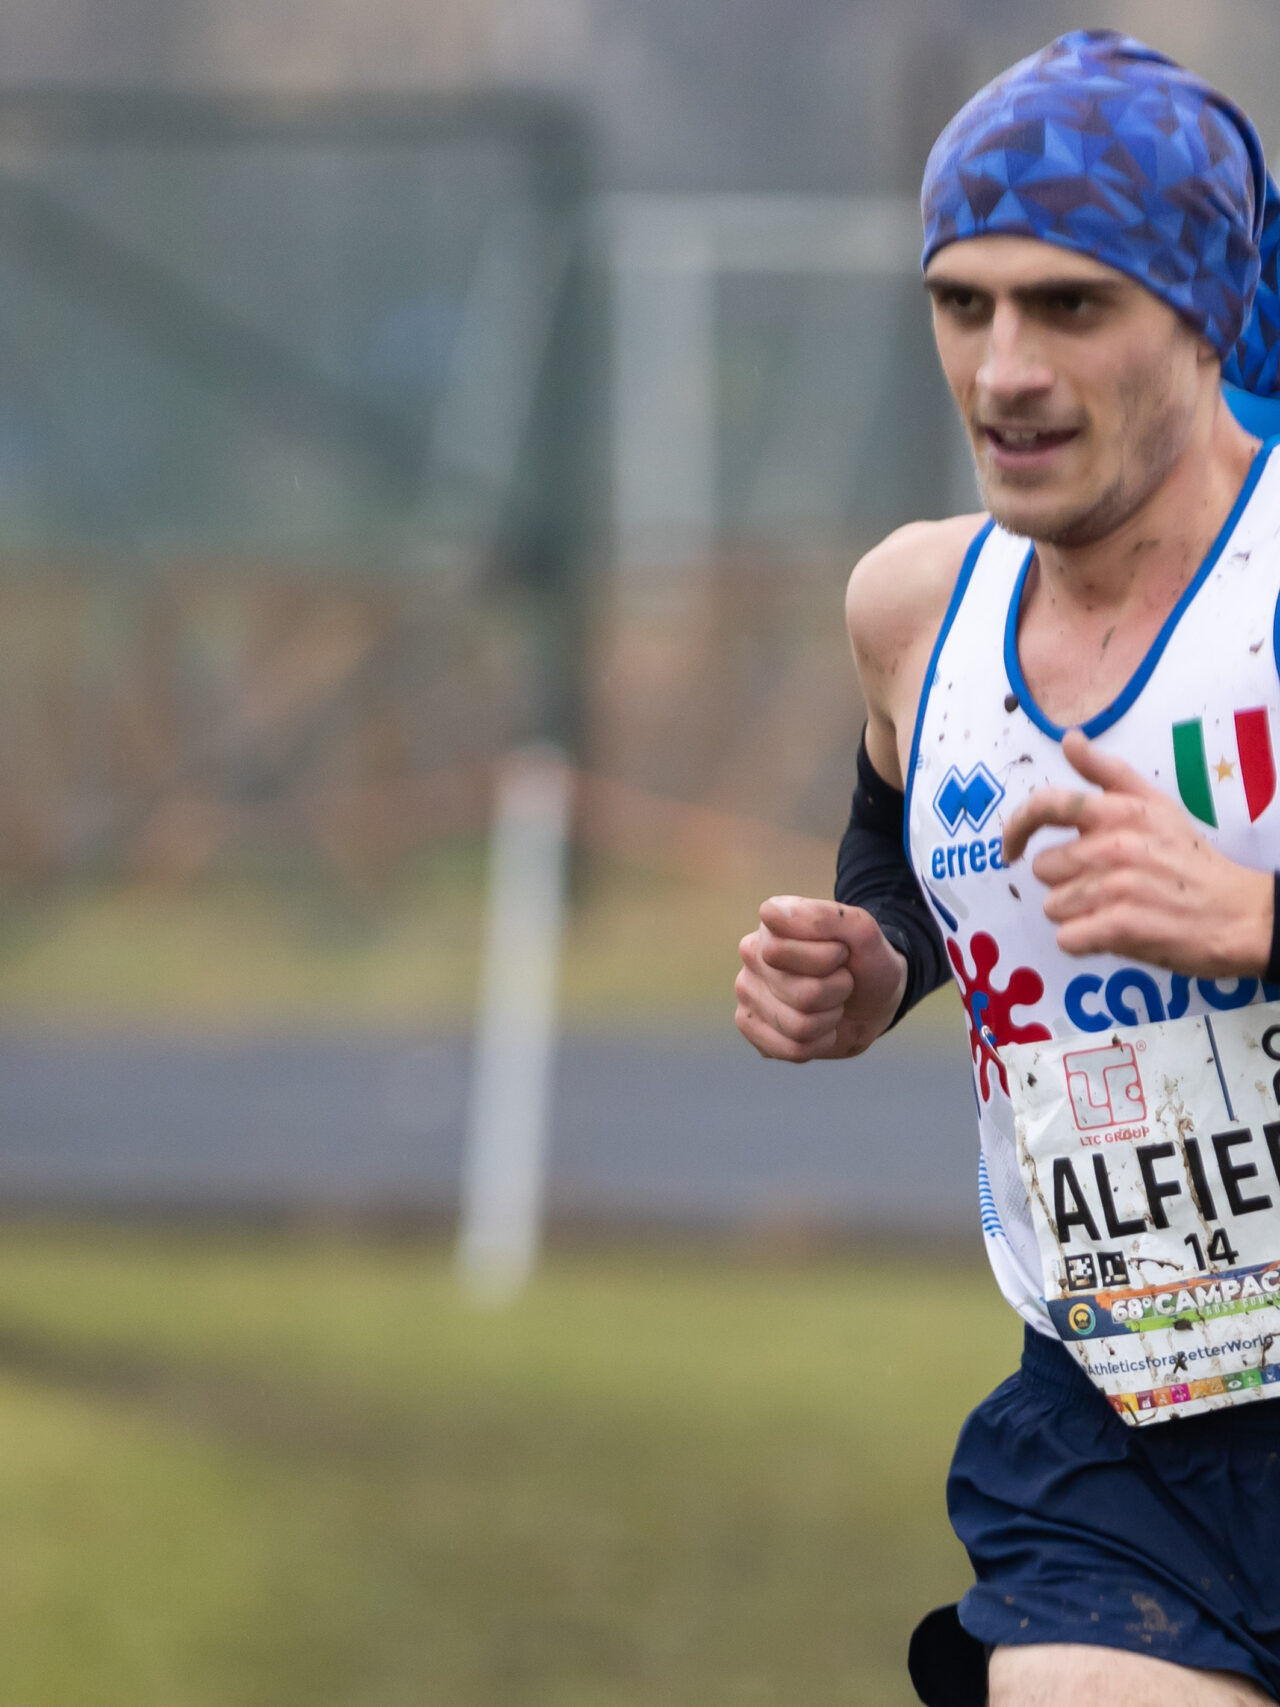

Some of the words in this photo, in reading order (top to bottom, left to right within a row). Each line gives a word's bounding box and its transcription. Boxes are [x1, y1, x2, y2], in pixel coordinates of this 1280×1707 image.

[1080, 1133, 1101, 1147] LTC
[1104, 1127, 1150, 1144] GROUP
[1184, 1227, 1239, 1271] 14
